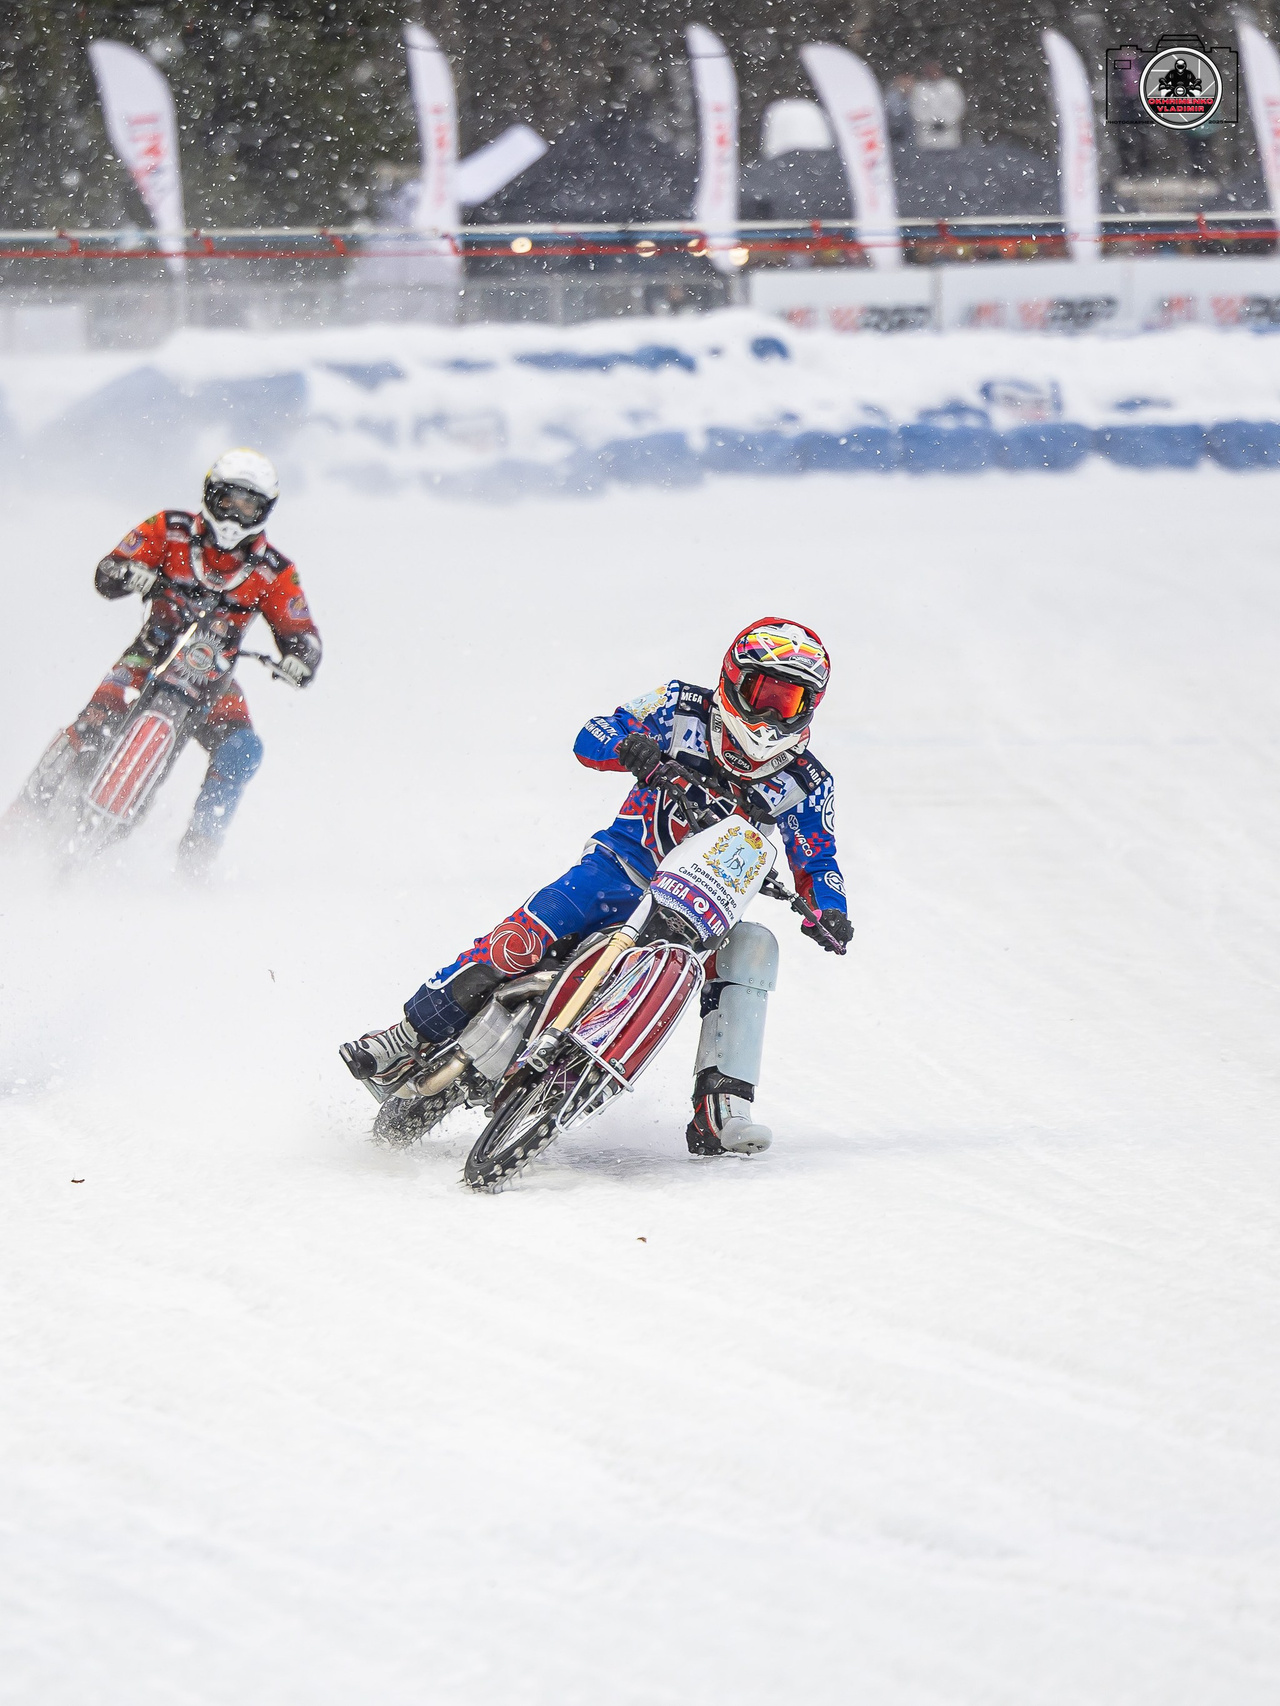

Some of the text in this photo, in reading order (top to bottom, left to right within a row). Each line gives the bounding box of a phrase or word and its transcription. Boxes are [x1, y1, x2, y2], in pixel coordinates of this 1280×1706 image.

[681, 691, 703, 704] MEGA
[806, 763, 822, 786] LADA
[794, 829, 813, 857] WACO
[678, 866, 718, 897] Самарской
[717, 894, 735, 921] области
[690, 862, 737, 909] Правительство
[657, 876, 691, 900] MEGA
[707, 913, 726, 937] LAD
